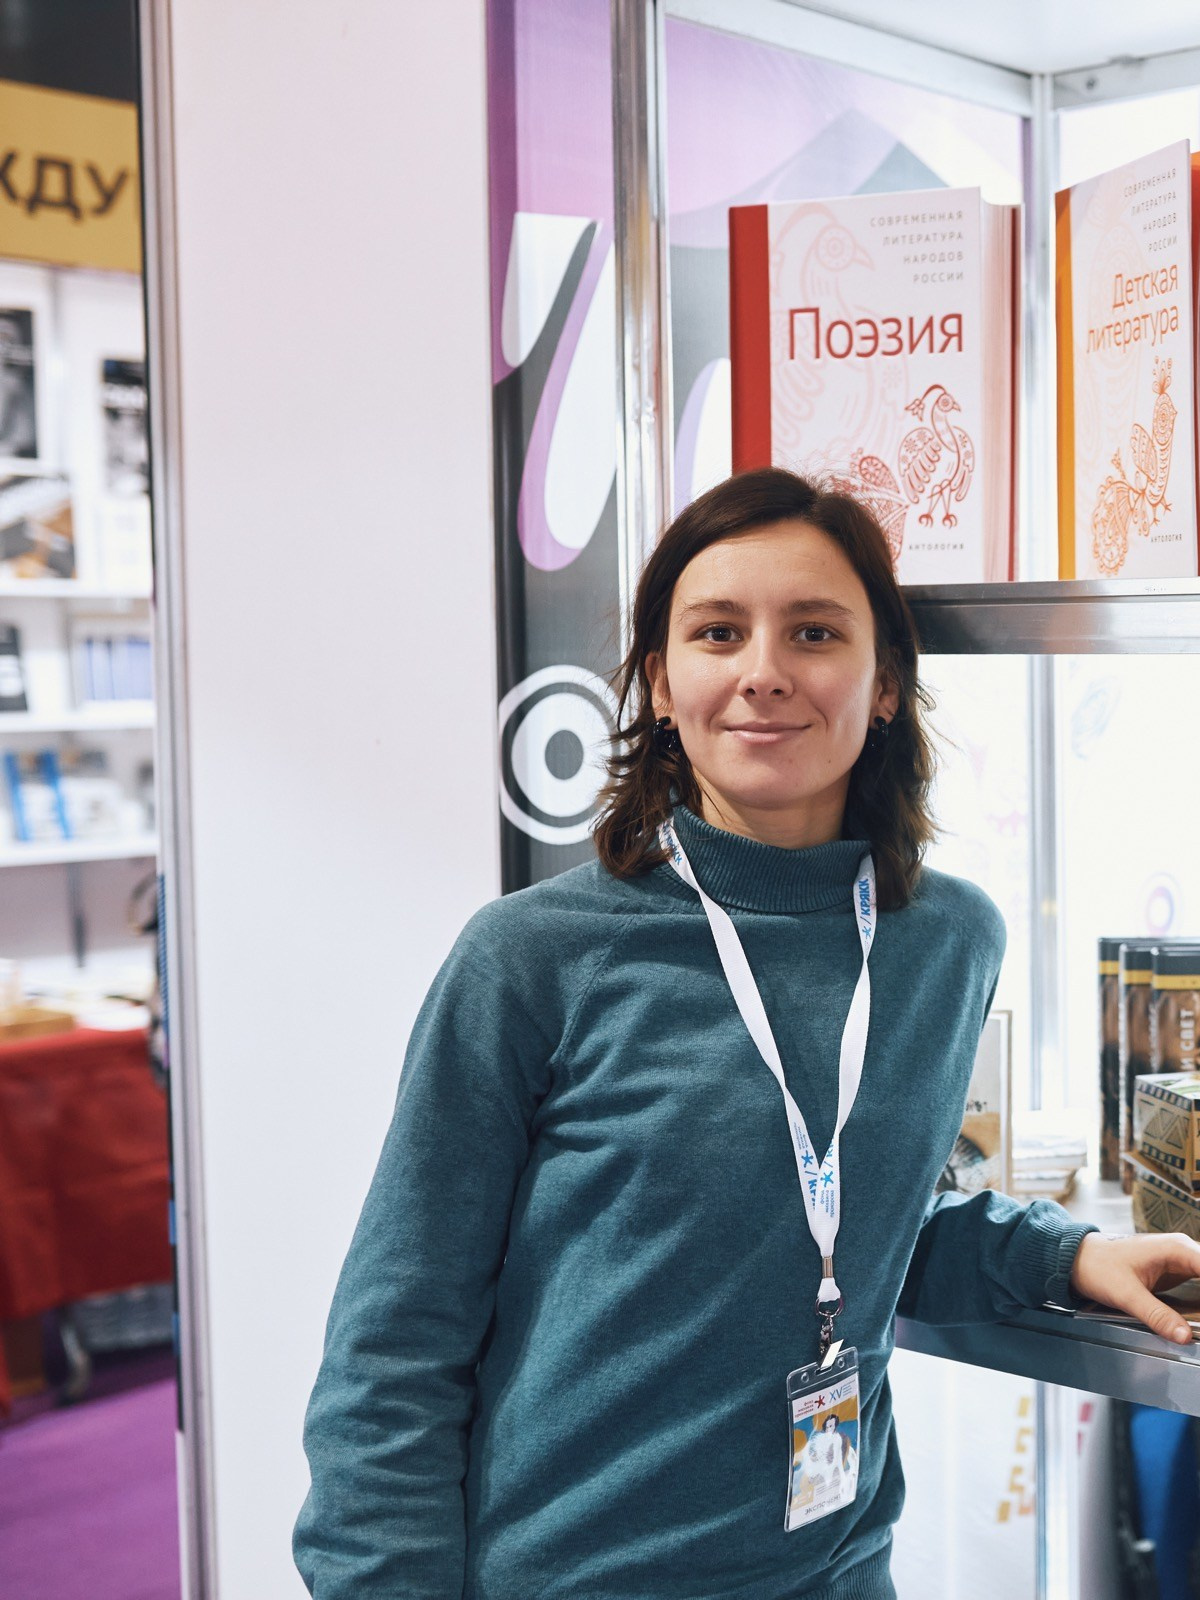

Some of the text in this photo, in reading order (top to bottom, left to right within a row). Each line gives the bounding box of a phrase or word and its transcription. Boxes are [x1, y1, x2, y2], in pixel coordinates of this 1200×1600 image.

[1124, 168, 1177, 198] СОВРЕМЕННАЯ
[1131, 191, 1177, 216] ЛИТЕРАТУРА
[869, 209, 963, 228] СОВРЕМЕННАЯ
[1142, 213, 1177, 233] НАРОДОВ
[882, 231, 963, 246] ЛИТЕРАТУРА
[1148, 235, 1178, 252] РОССИИ
[903, 250, 964, 264] НАРОДОВ
[912, 271, 964, 284] РОССИИ
[1112, 264, 1179, 311] Детская
[788, 307, 963, 360] Поэзия
[1086, 305, 1180, 354] литература
[858, 878, 871, 917] КРЯКК
